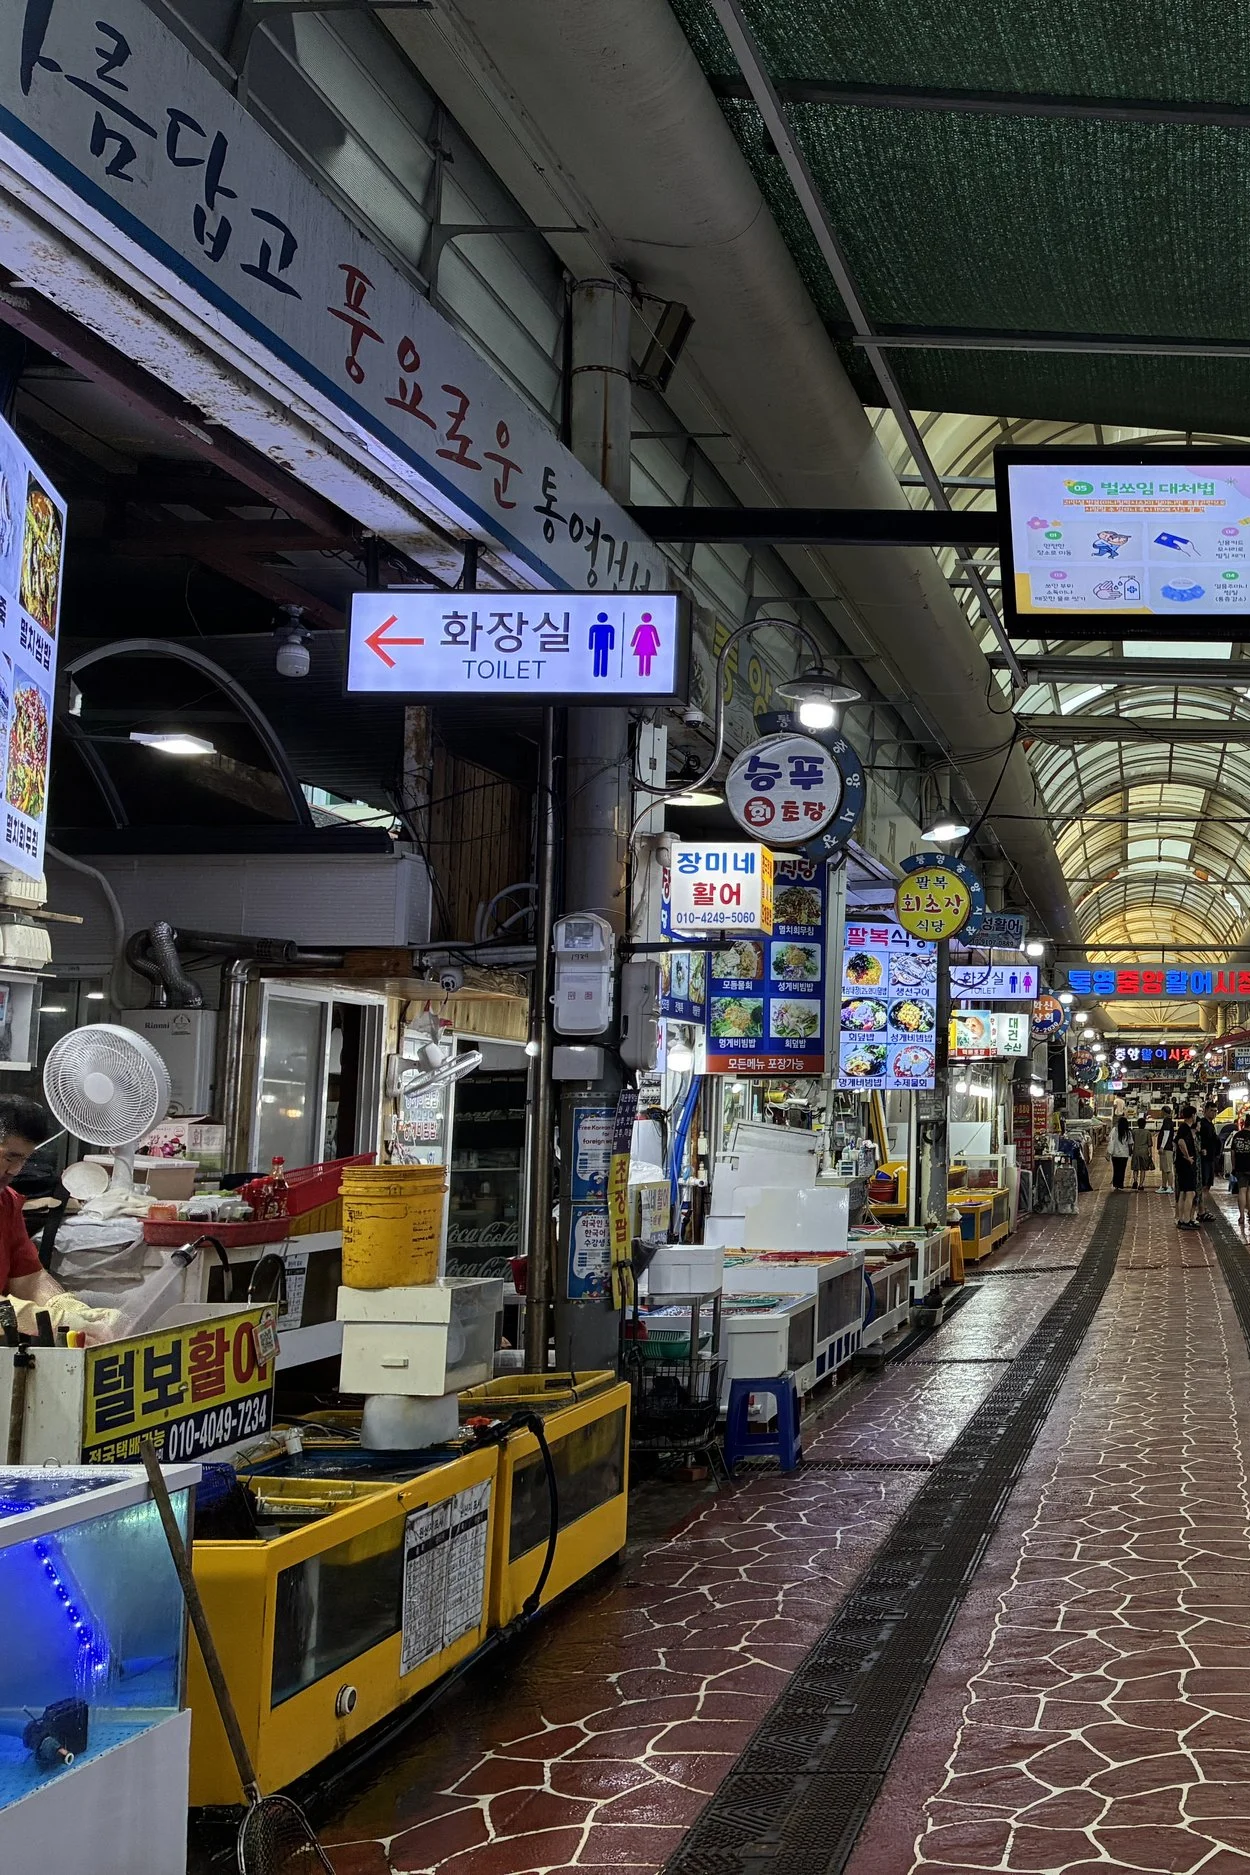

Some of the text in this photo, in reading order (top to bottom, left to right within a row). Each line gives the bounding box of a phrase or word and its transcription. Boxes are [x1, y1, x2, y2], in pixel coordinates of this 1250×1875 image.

[327, 264, 523, 510] 풍요로운
[1100, 481, 1154, 496] 벌쏘임
[1158, 481, 1216, 496] 대처법
[440, 611, 571, 653] 화장실
[462, 660, 546, 680] TOILET
[781, 800, 826, 823] 초장
[676, 852, 756, 875] 장미네
[916, 875, 949, 890] 팔복
[692, 882, 742, 907] 활어
[901, 893, 964, 915] 회초장
[676, 912, 756, 924] 010-4249-5060
[916, 919, 946, 933] 식당
[728, 1058, 804, 1070] 모든메뉴 포장가능
[583, 1138, 605, 1146] foreign
[169, 1394, 267, 1462] 010-4049-7234
